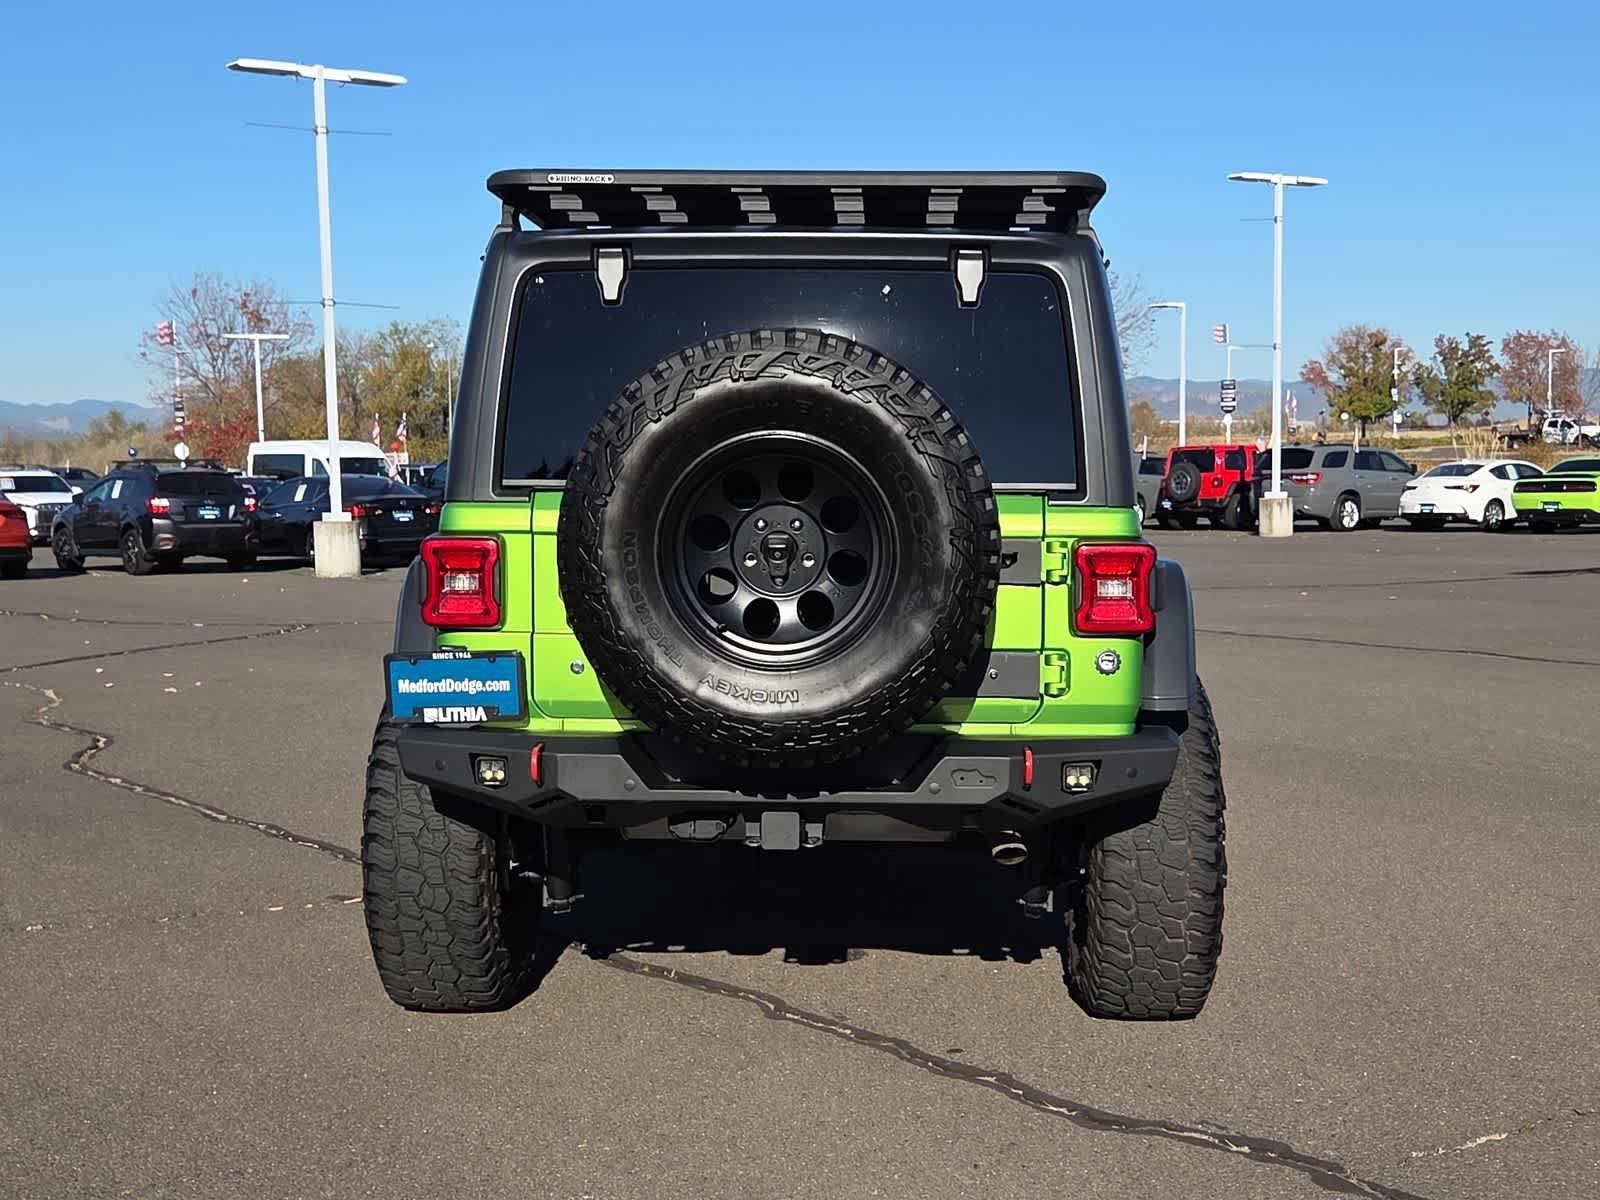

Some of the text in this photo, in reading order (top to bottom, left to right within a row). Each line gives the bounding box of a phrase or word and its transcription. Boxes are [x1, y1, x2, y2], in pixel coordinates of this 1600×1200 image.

[624, 529, 799, 704] MICKEY THOMPSON
[432, 652, 454, 660] SINCE
[398, 678, 511, 695] MedfordDodge.com
[438, 706, 488, 722] LITHIA
